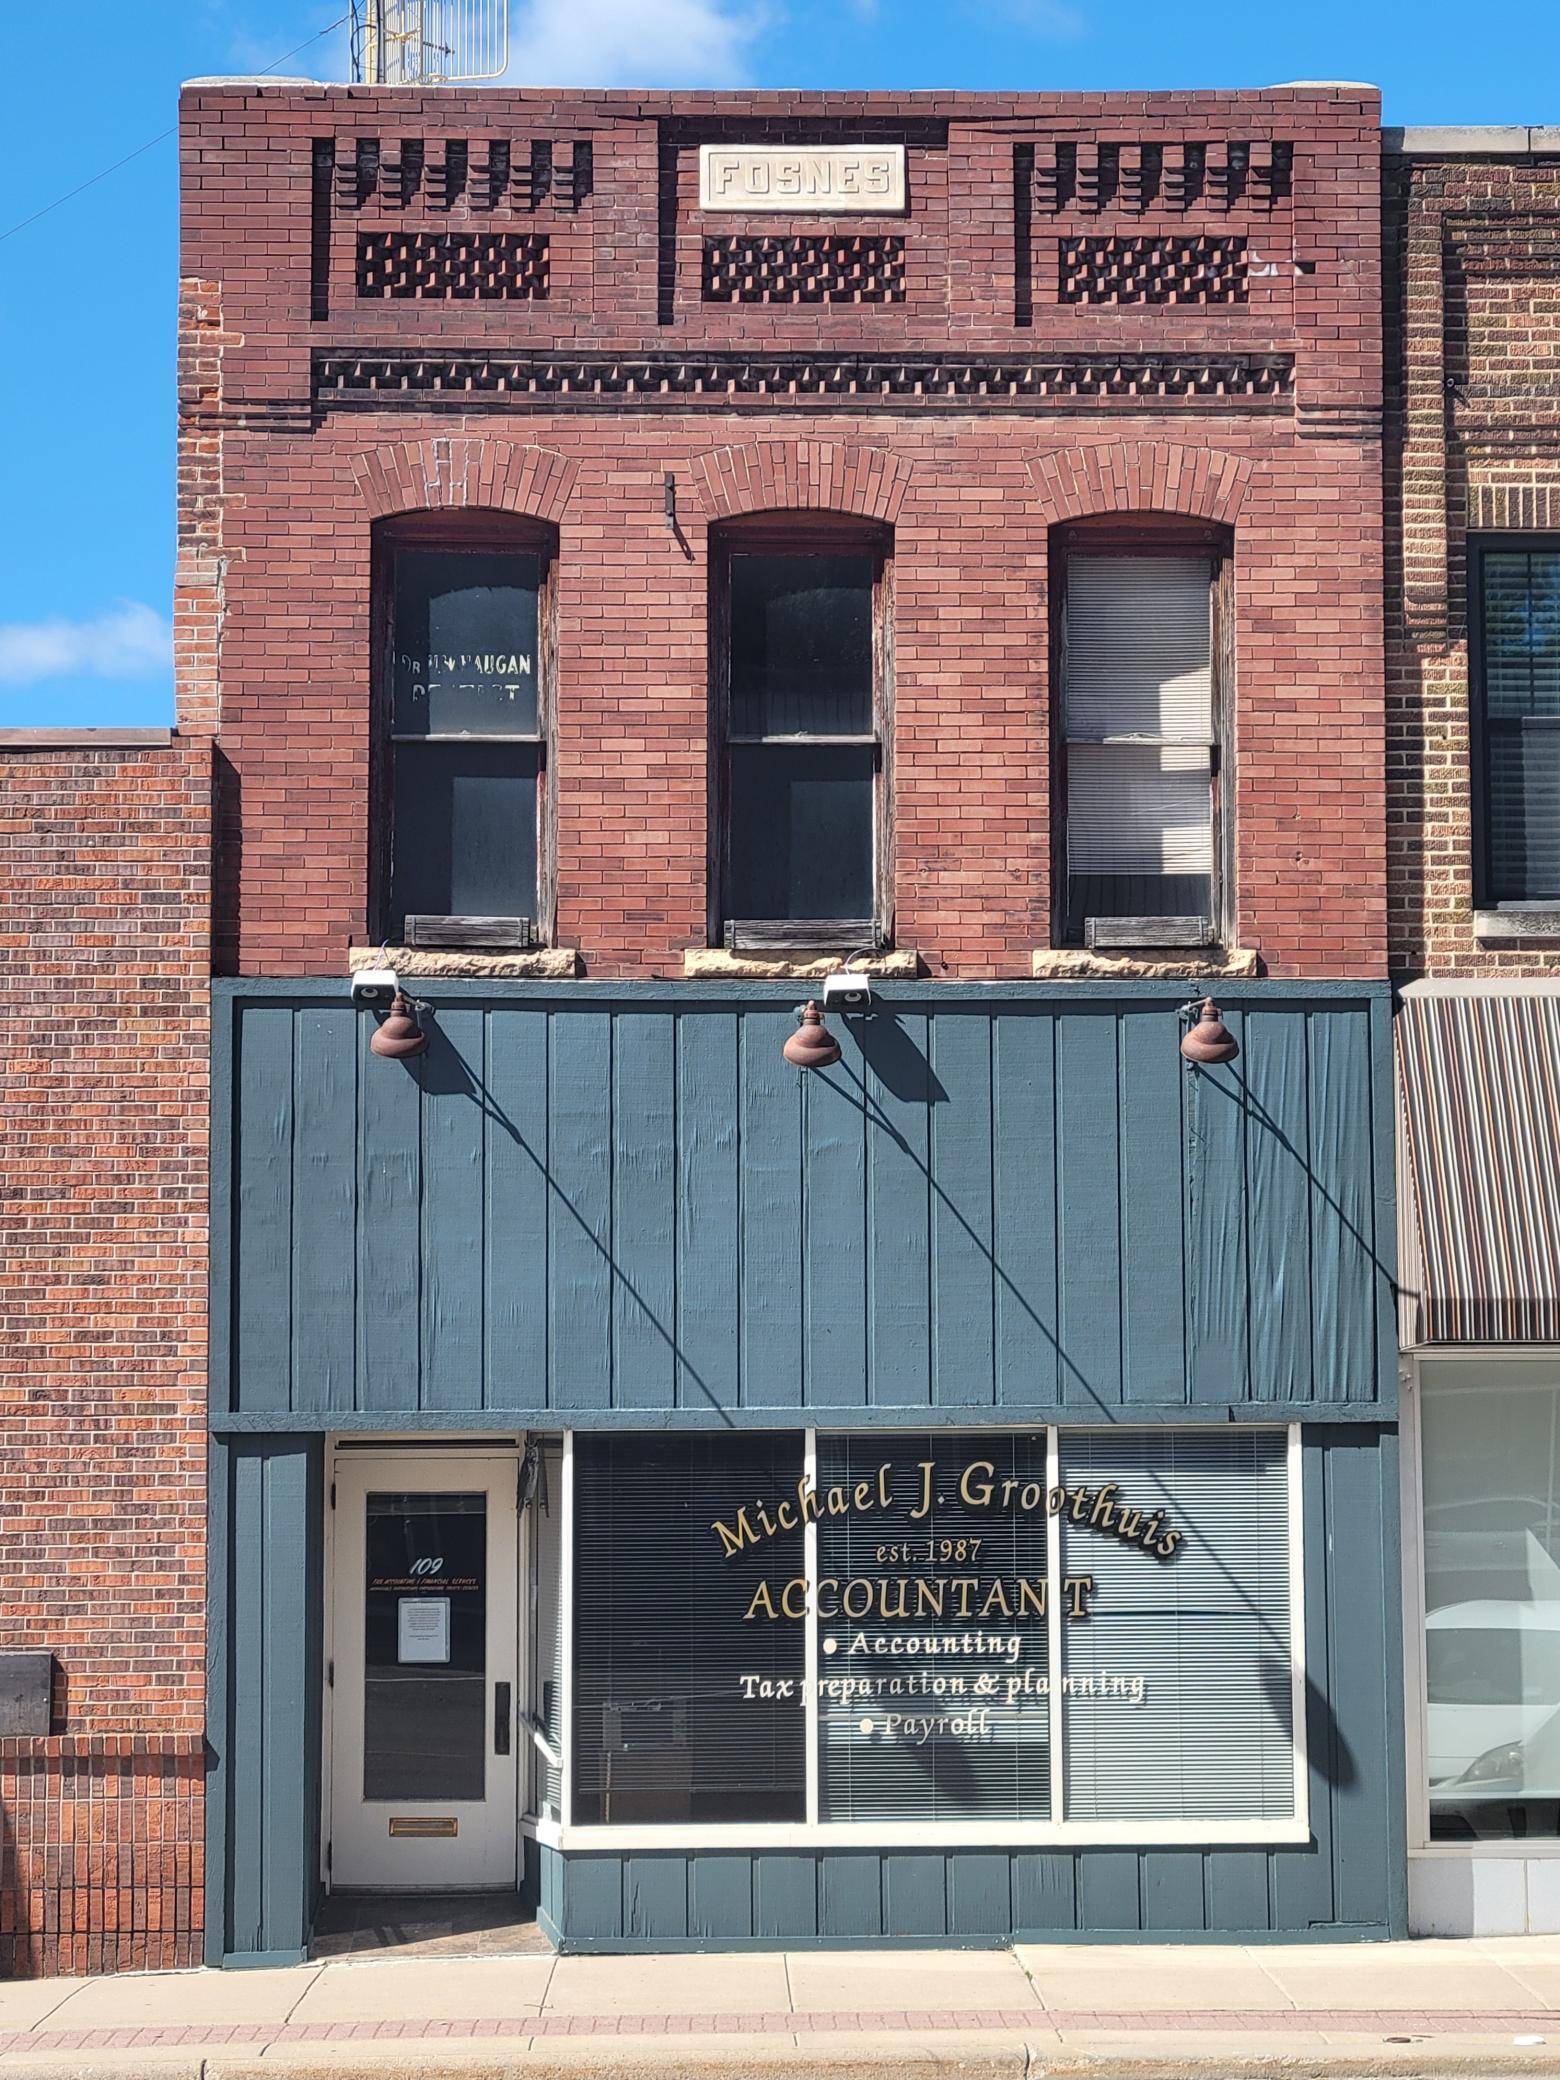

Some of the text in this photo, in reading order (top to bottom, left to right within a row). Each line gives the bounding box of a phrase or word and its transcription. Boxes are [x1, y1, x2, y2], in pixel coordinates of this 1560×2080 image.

[715, 160, 890, 194] FOSNES
[711, 1461, 1181, 1559] Michael J. Groothuis
[409, 1557, 444, 1575] 109
[876, 1537, 982, 1562] est. 1987
[742, 1578, 1094, 1619] ACCOUNTANT
[848, 1631, 1022, 1664] Accounting
[740, 1675, 794, 1700] Tax
[973, 1673, 1000, 1694] &
[1004, 1668, 1145, 1704] planning
[884, 1707, 991, 1746] Payroll
